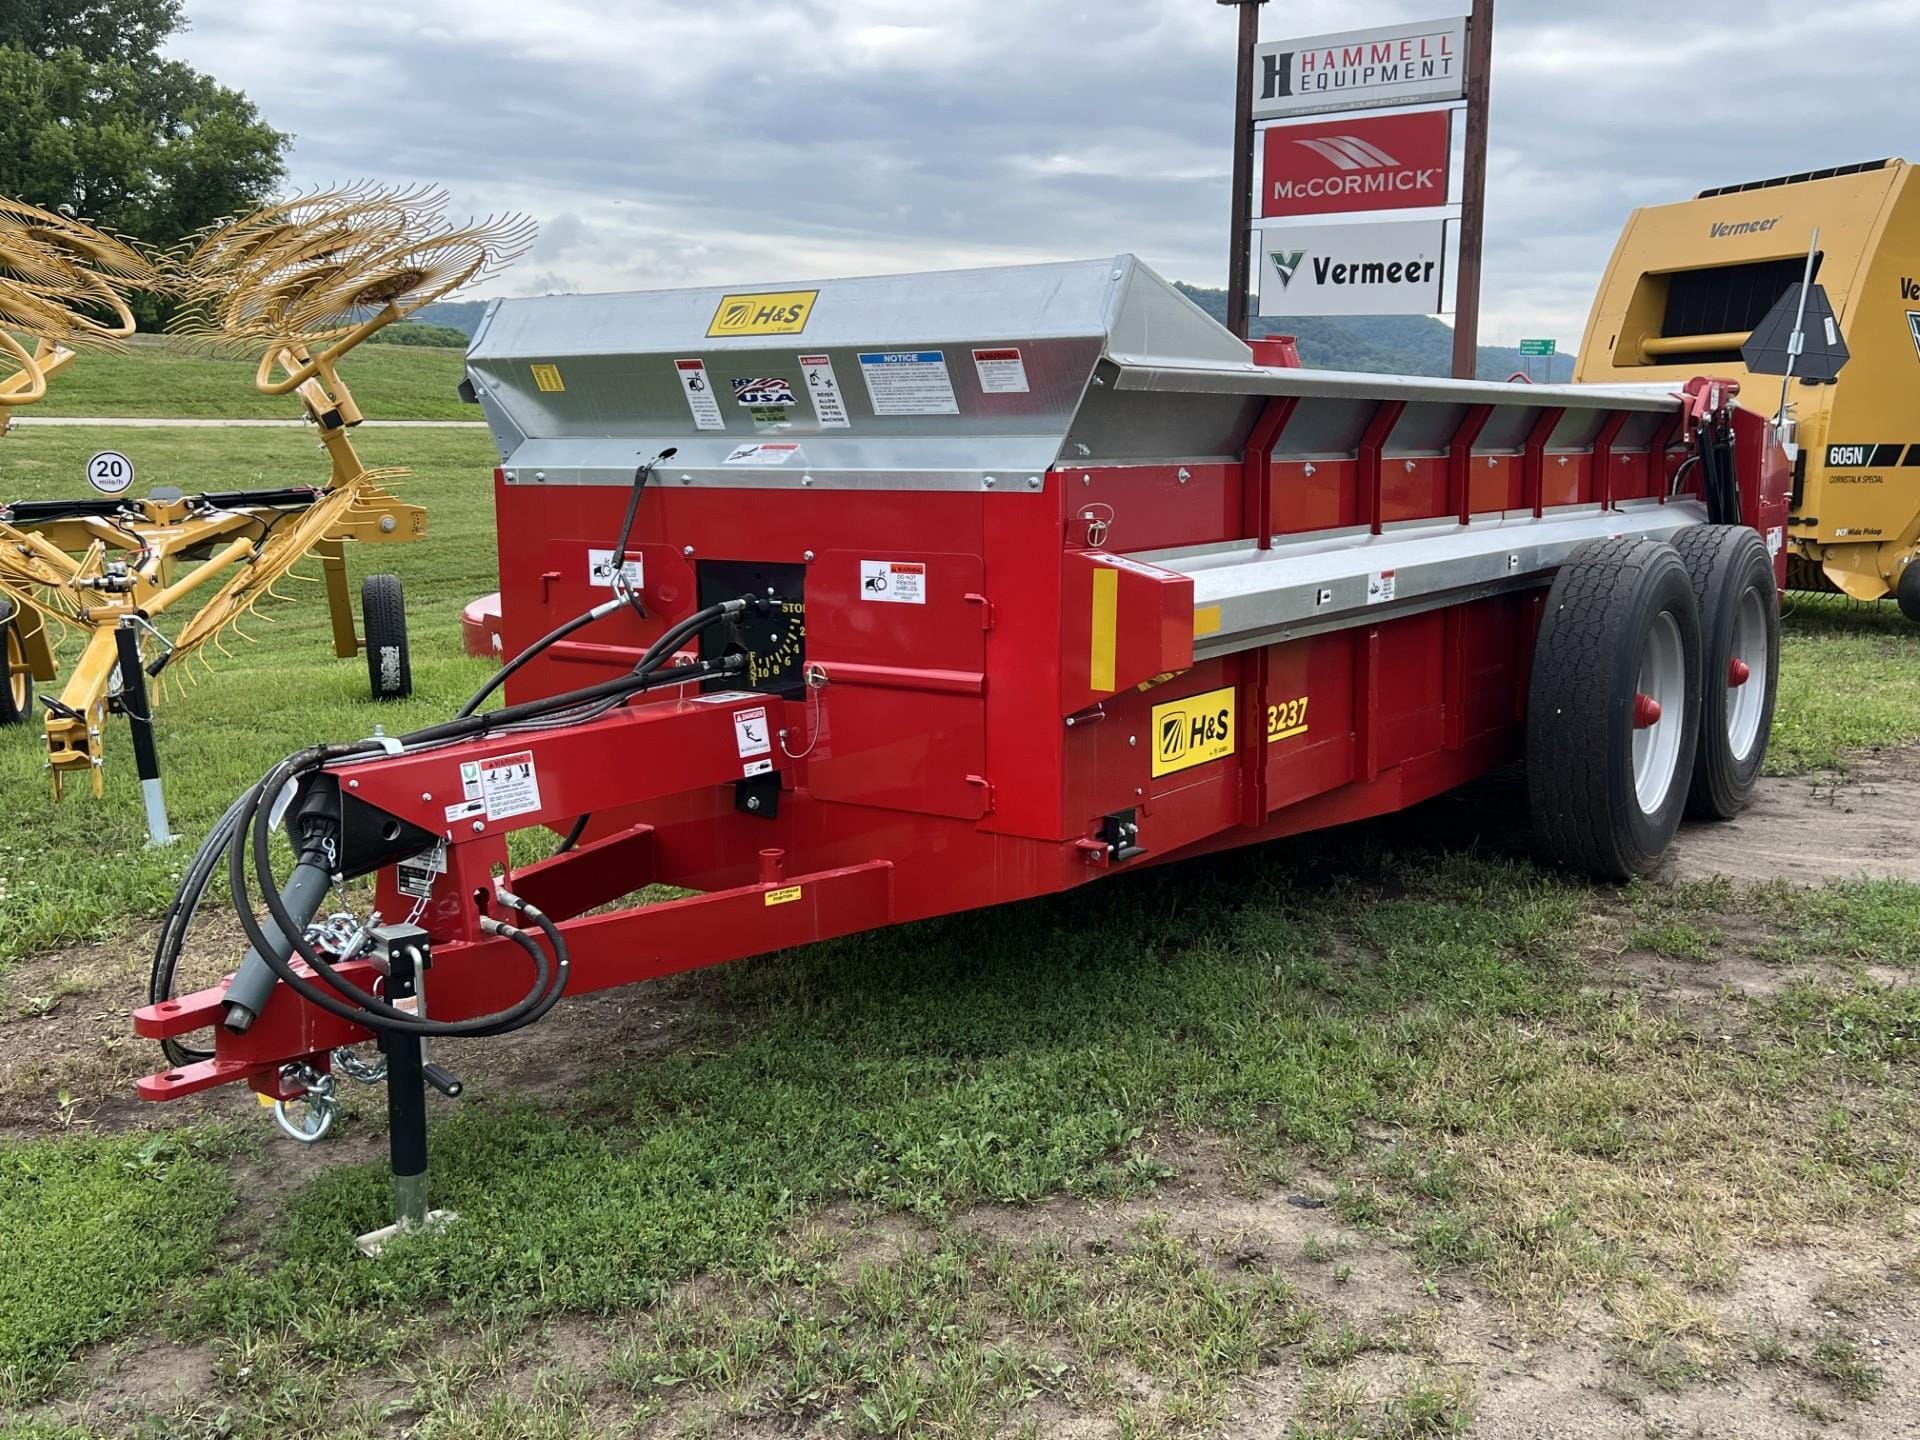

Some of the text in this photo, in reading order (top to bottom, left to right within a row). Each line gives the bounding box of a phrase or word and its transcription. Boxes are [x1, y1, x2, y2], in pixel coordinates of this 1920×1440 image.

[1301, 35, 1453, 73] HAMMELL
[1301, 57, 1453, 91] EQUIPMENT
[1710, 218, 1778, 238] Vermeer
[1313, 257, 1435, 285] Vermeer
[1900, 277, 1920, 301] Ve
[752, 304, 804, 325] H&S
[884, 353, 919, 362] NOTICE
[739, 393, 797, 403] USA
[1829, 446, 1864, 465] 605N
[97, 461, 122, 477] 20
[1829, 475, 1884, 485] CORNSTALK SPECIAL
[1847, 528, 1861, 536] Wide
[1863, 528, 1882, 537] Pickup
[800, 626, 806, 636] 2
[793, 643, 800, 654] 4
[784, 656, 791, 666] 6
[758, 665, 780, 678] 10 8
[1268, 696, 1309, 733] 3237
[1190, 709, 1229, 749] H&S
